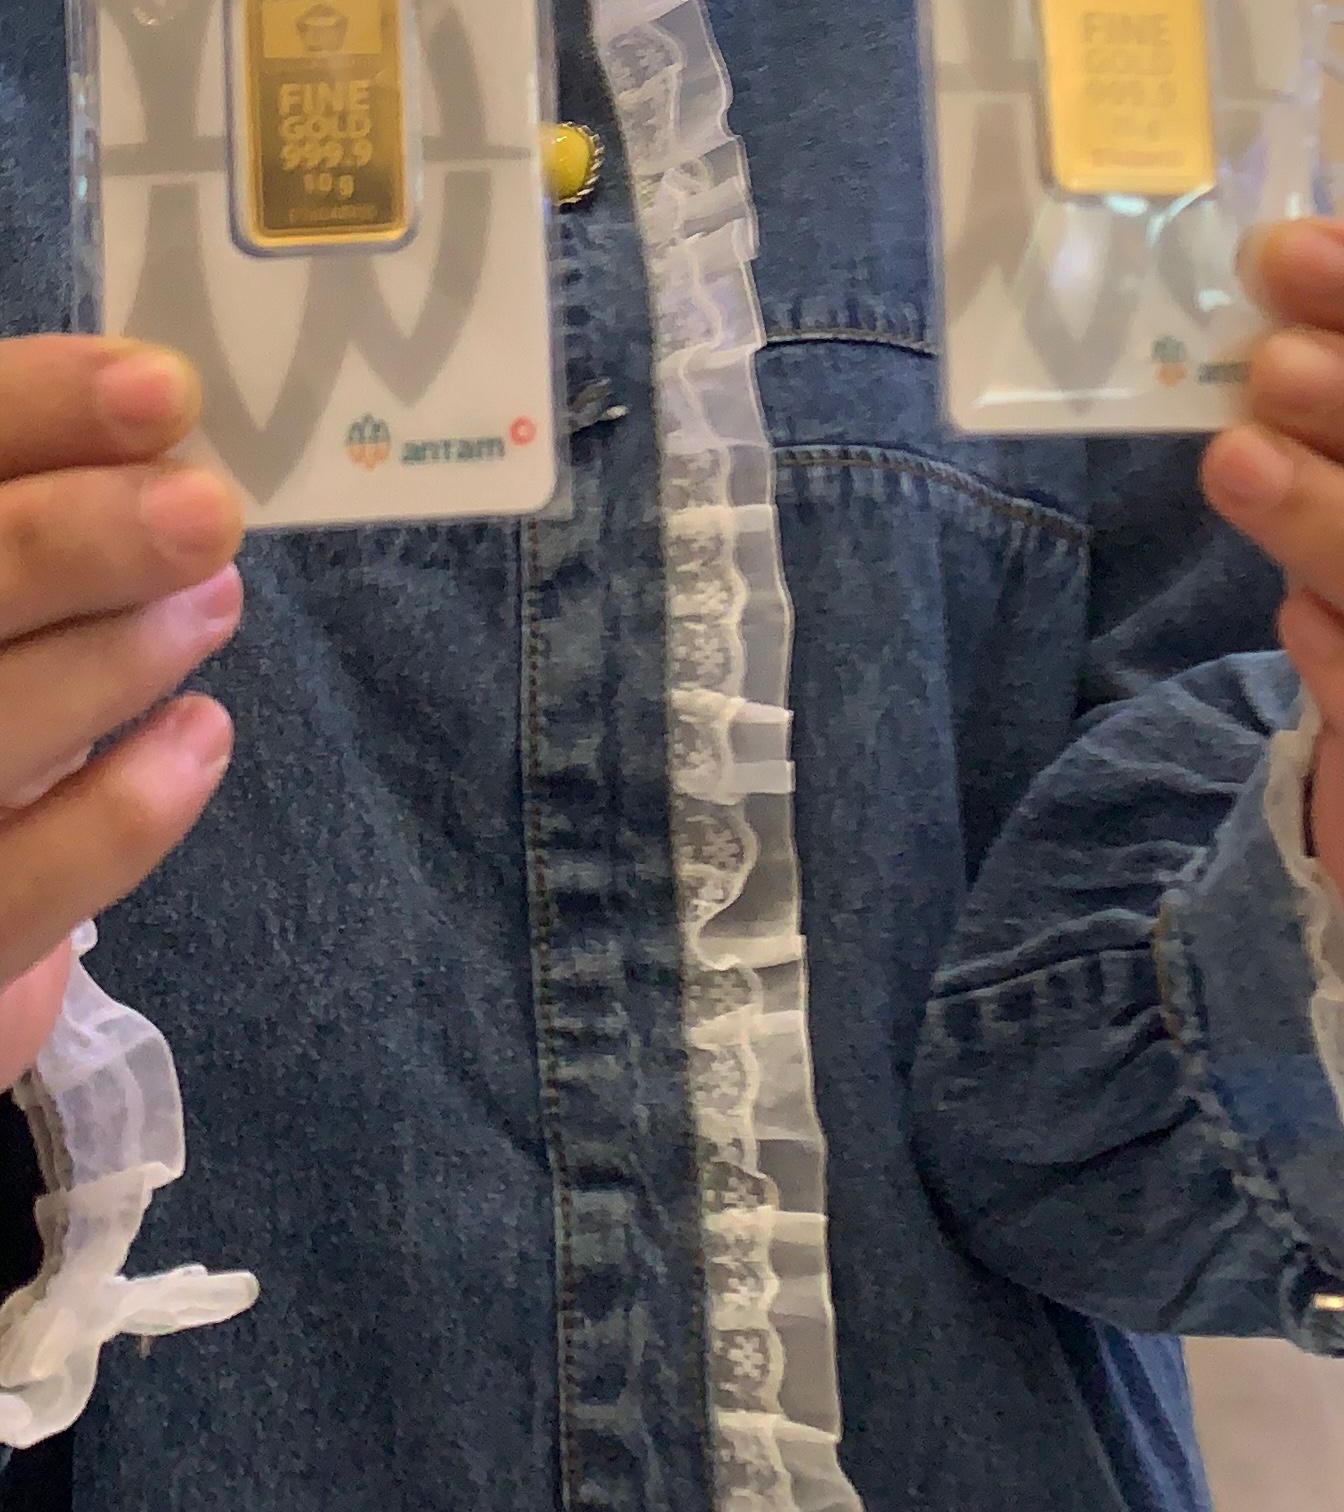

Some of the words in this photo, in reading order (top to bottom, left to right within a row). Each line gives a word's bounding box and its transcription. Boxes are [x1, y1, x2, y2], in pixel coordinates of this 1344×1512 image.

[278, 79, 370, 116] FINE
[279, 111, 372, 142] GOLD
[402, 438, 505, 464] antam
